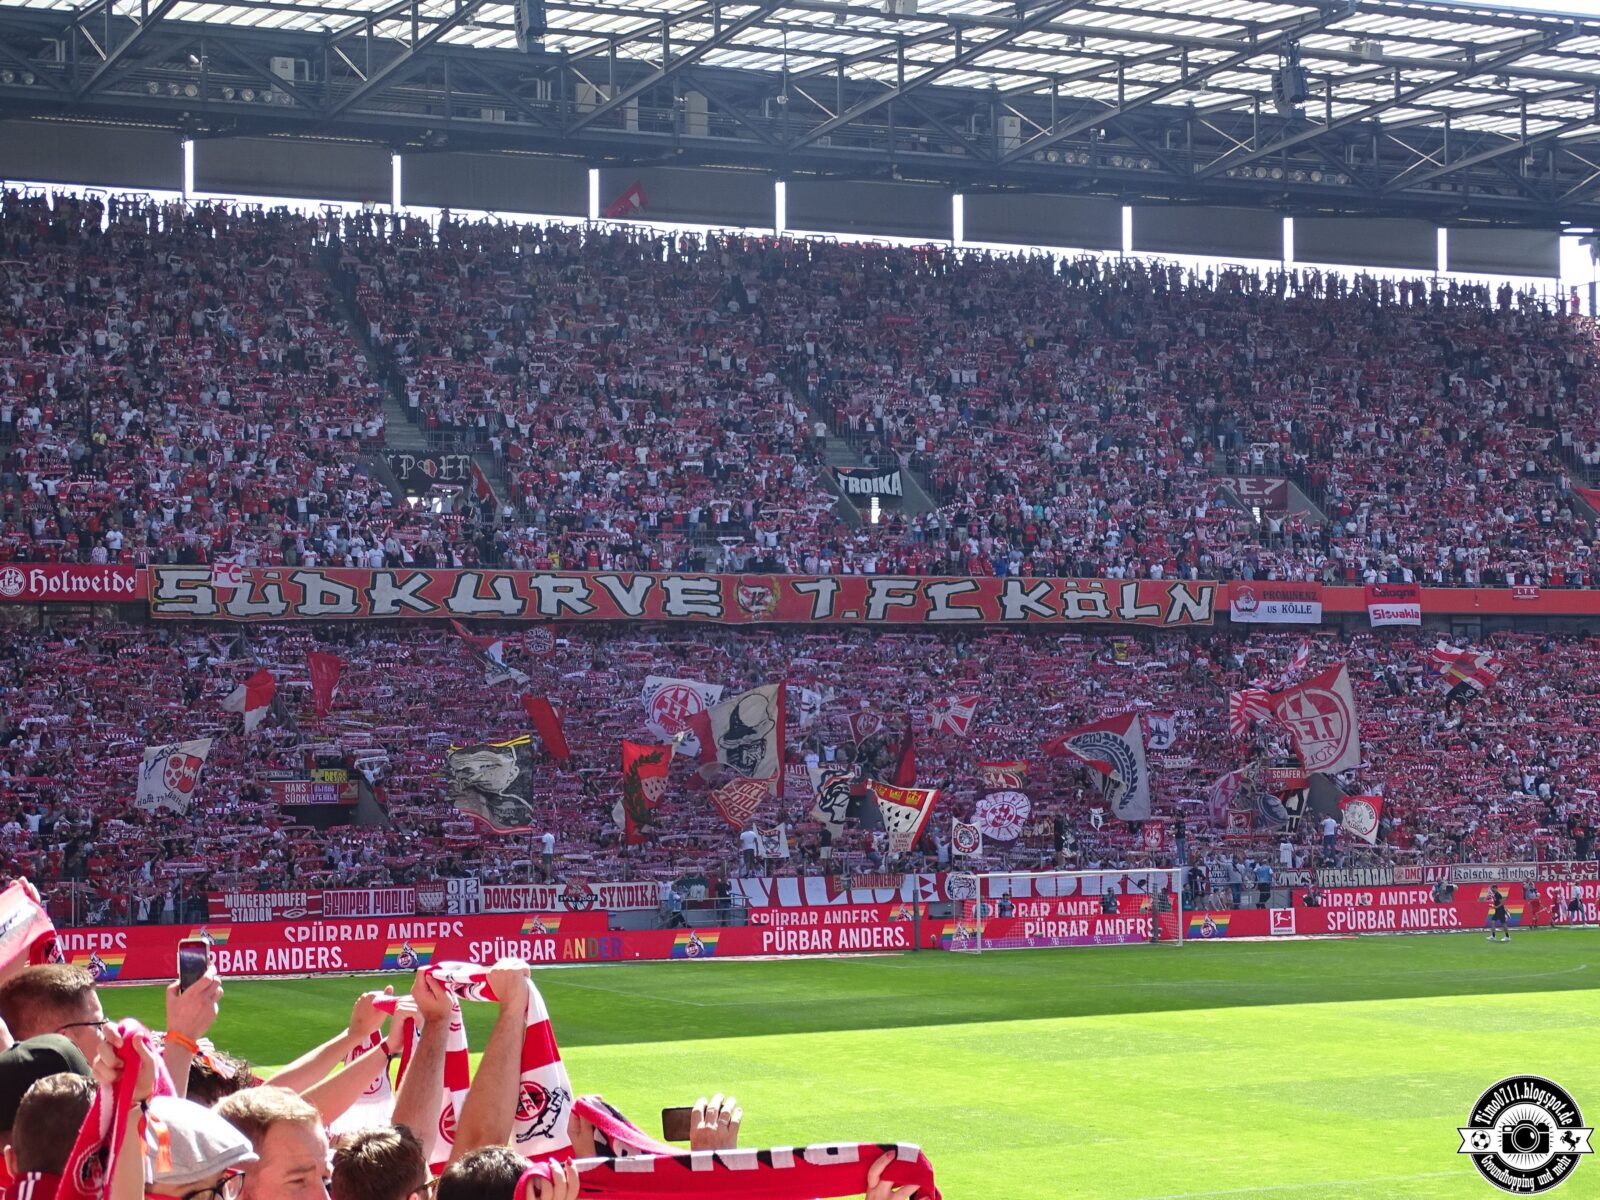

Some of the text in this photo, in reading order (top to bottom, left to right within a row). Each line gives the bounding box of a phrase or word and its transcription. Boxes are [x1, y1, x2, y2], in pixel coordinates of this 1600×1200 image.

[837, 470, 902, 496] TROIKA
[29, 568, 135, 597] Holweide
[998, 579, 1214, 622] KÖLN
[1281, 603, 1312, 615] KÖLLE
[285, 783, 306, 793] HANS
[224, 891, 307, 908] MÜNGERSDORFER
[324, 888, 415, 915] SEMPER FIDELIS
[483, 884, 557, 910] DOMSTADT
[231, 906, 272, 922] STADION
[1327, 906, 1462, 931] SPÜRBAR ANDERS.
[469, 935, 557, 963] SPÜRBAR
[838, 925, 910, 949] ANDERS.
[265, 946, 348, 971] ANDERS.
